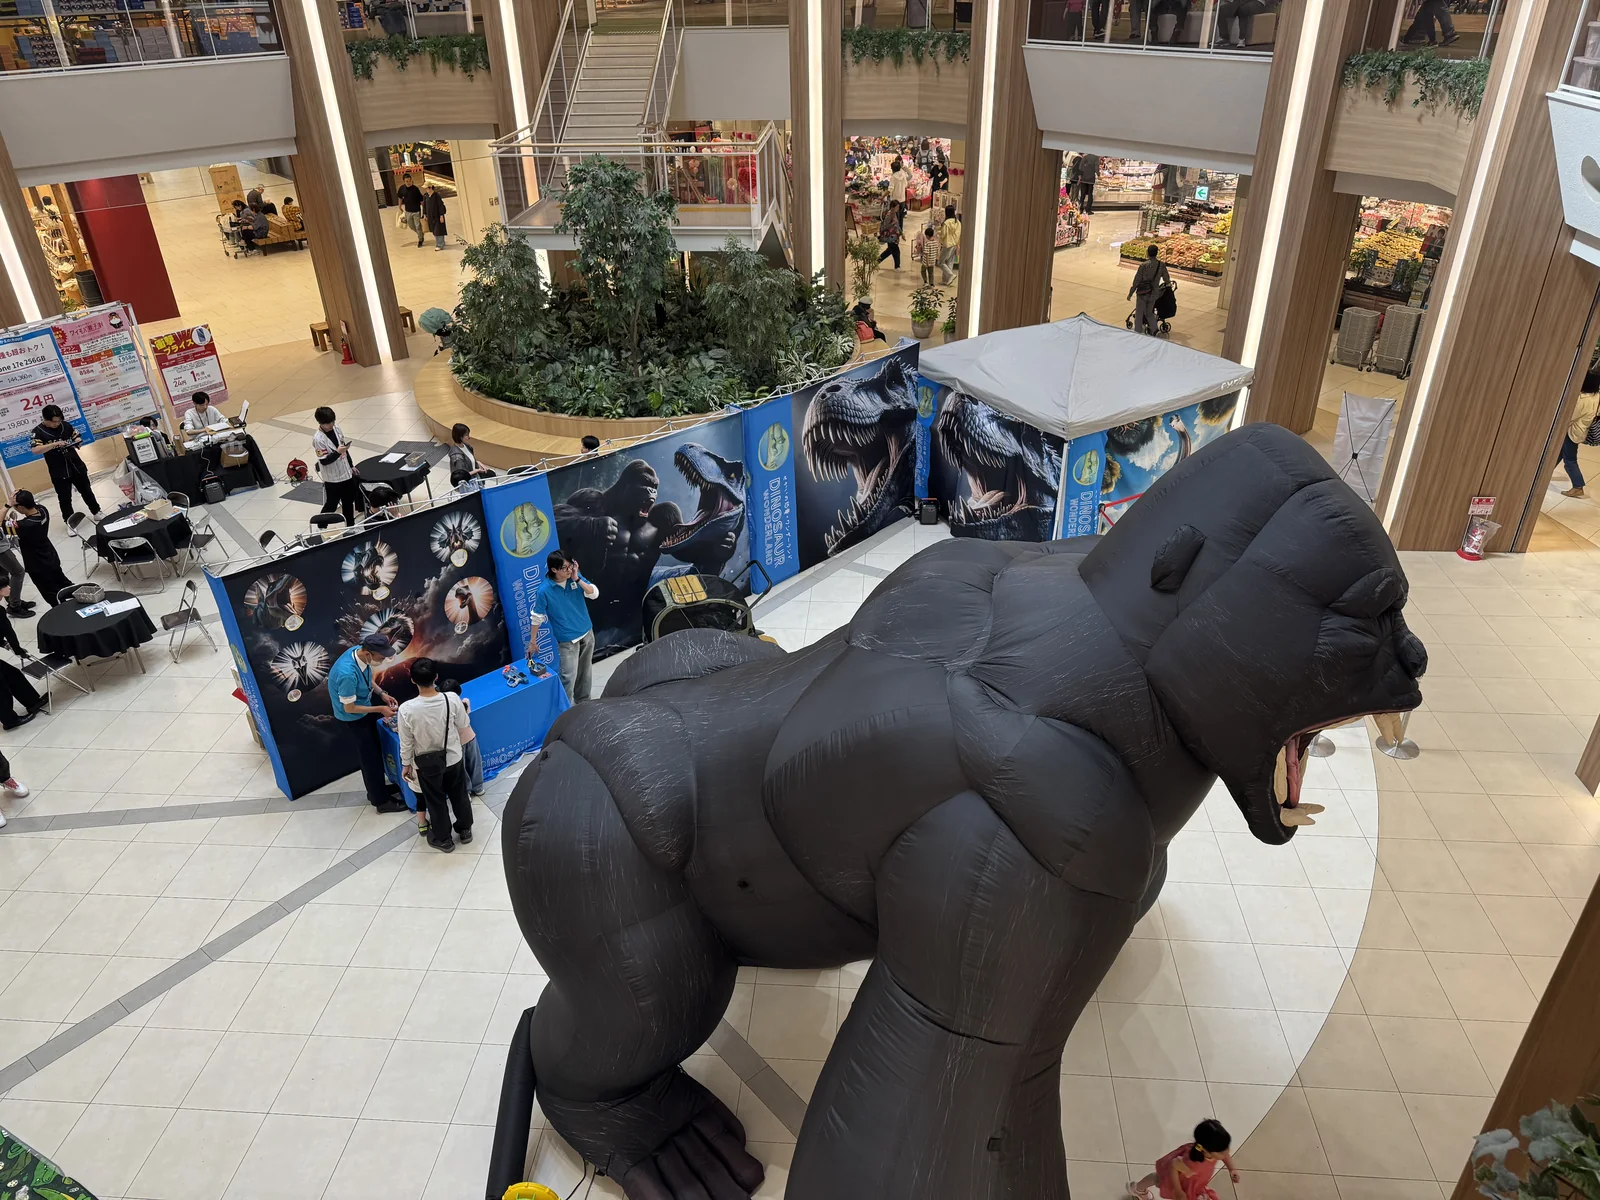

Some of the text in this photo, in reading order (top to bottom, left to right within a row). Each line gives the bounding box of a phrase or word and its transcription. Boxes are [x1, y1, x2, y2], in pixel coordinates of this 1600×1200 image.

[20, 393, 55, 411] 24円
[763, 488, 773, 566] WONDERLAND
[769, 476, 785, 569] DINOSAUR
[1078, 491, 1093, 536] DINOS
[511, 578, 532, 656] WONDERLA
[522, 564, 555, 665] DINAUR
